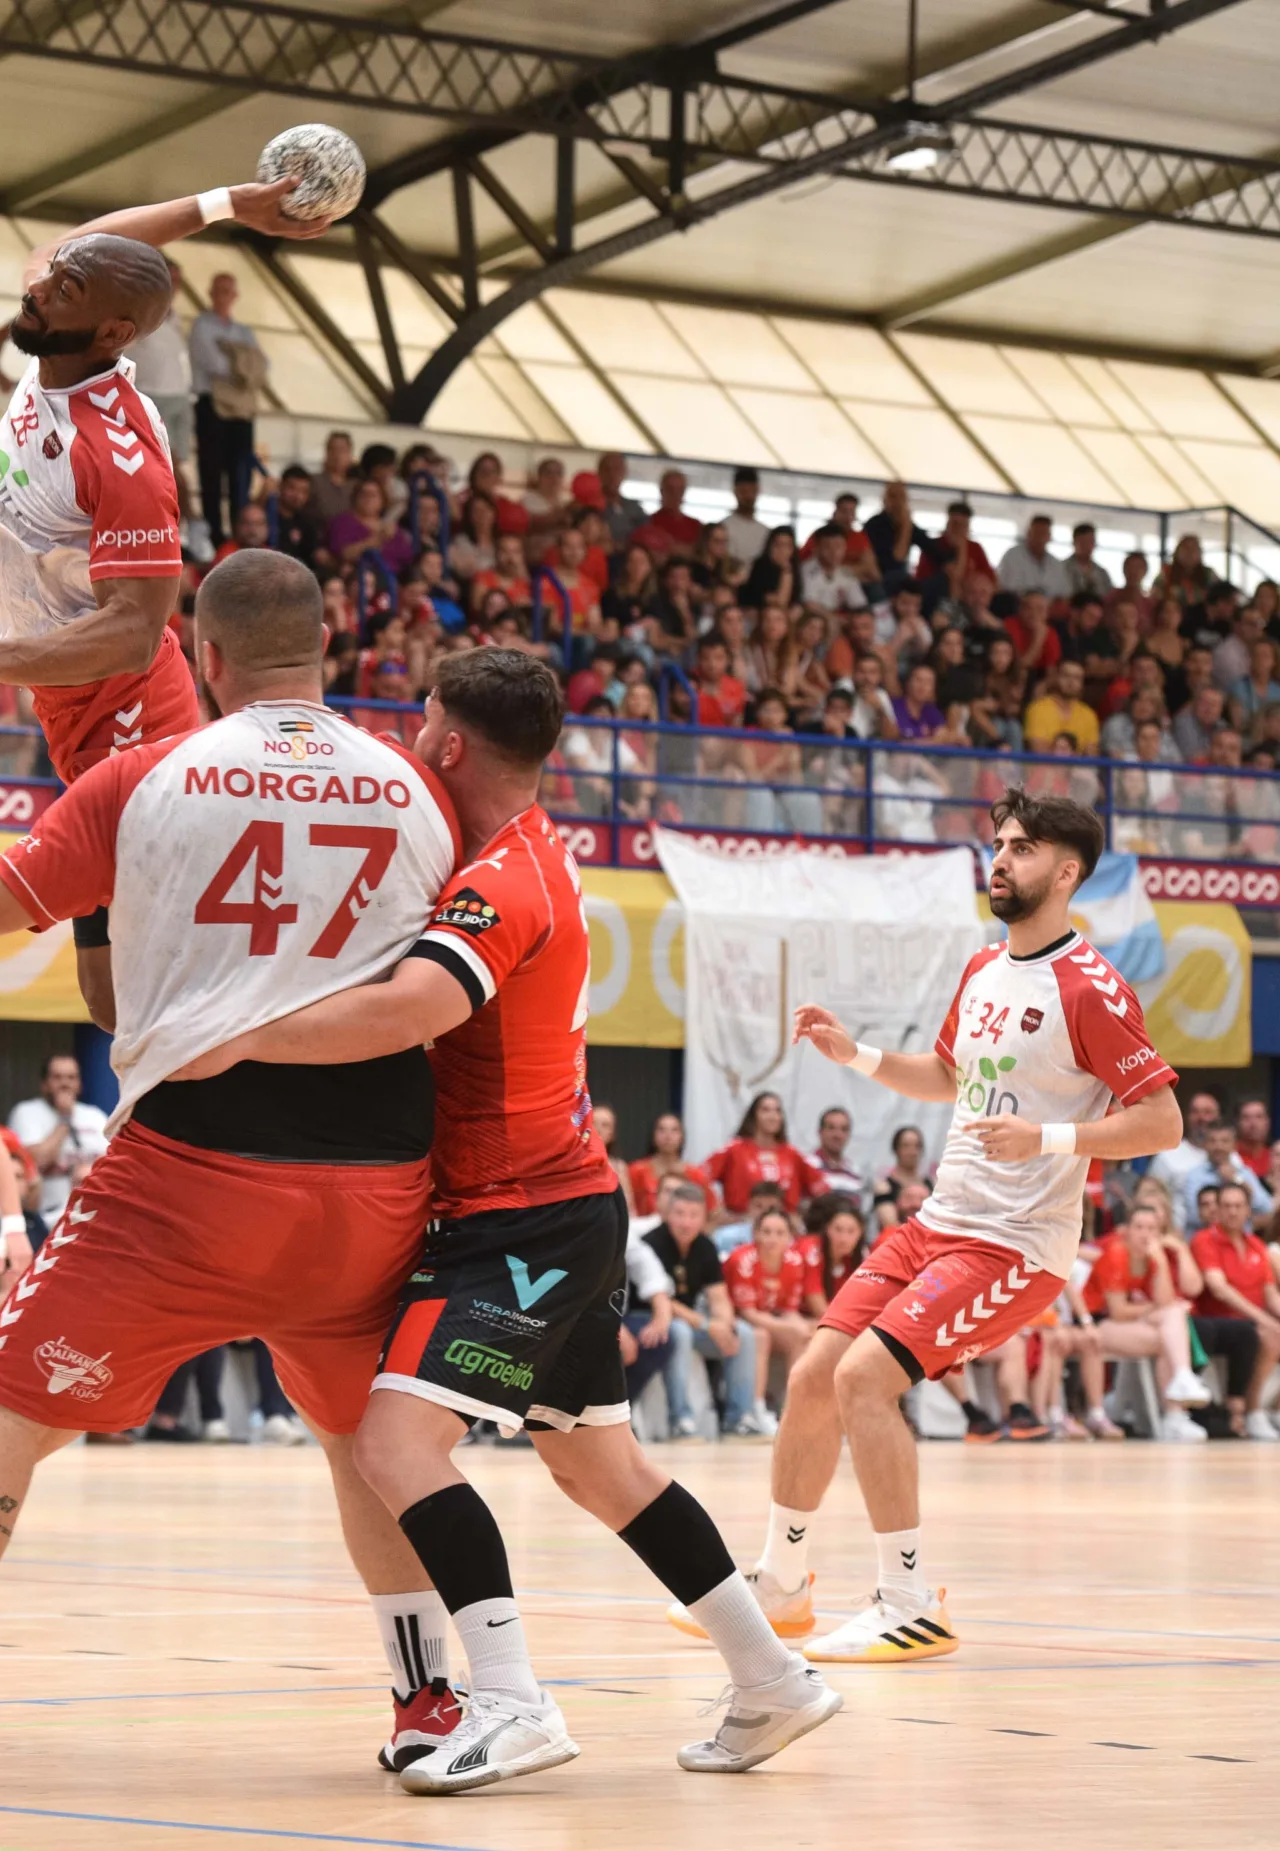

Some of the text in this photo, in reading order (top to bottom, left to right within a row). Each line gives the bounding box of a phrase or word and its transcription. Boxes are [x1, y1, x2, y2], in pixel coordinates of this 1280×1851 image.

[184, 766, 411, 809] MORGADO
[194, 819, 398, 960] 47
[452, 911, 492, 929] EJIDO
[970, 1002, 1010, 1045] 34
[1116, 1047, 1157, 1075] Kopp
[472, 1299, 548, 1328] VERAIMPOR
